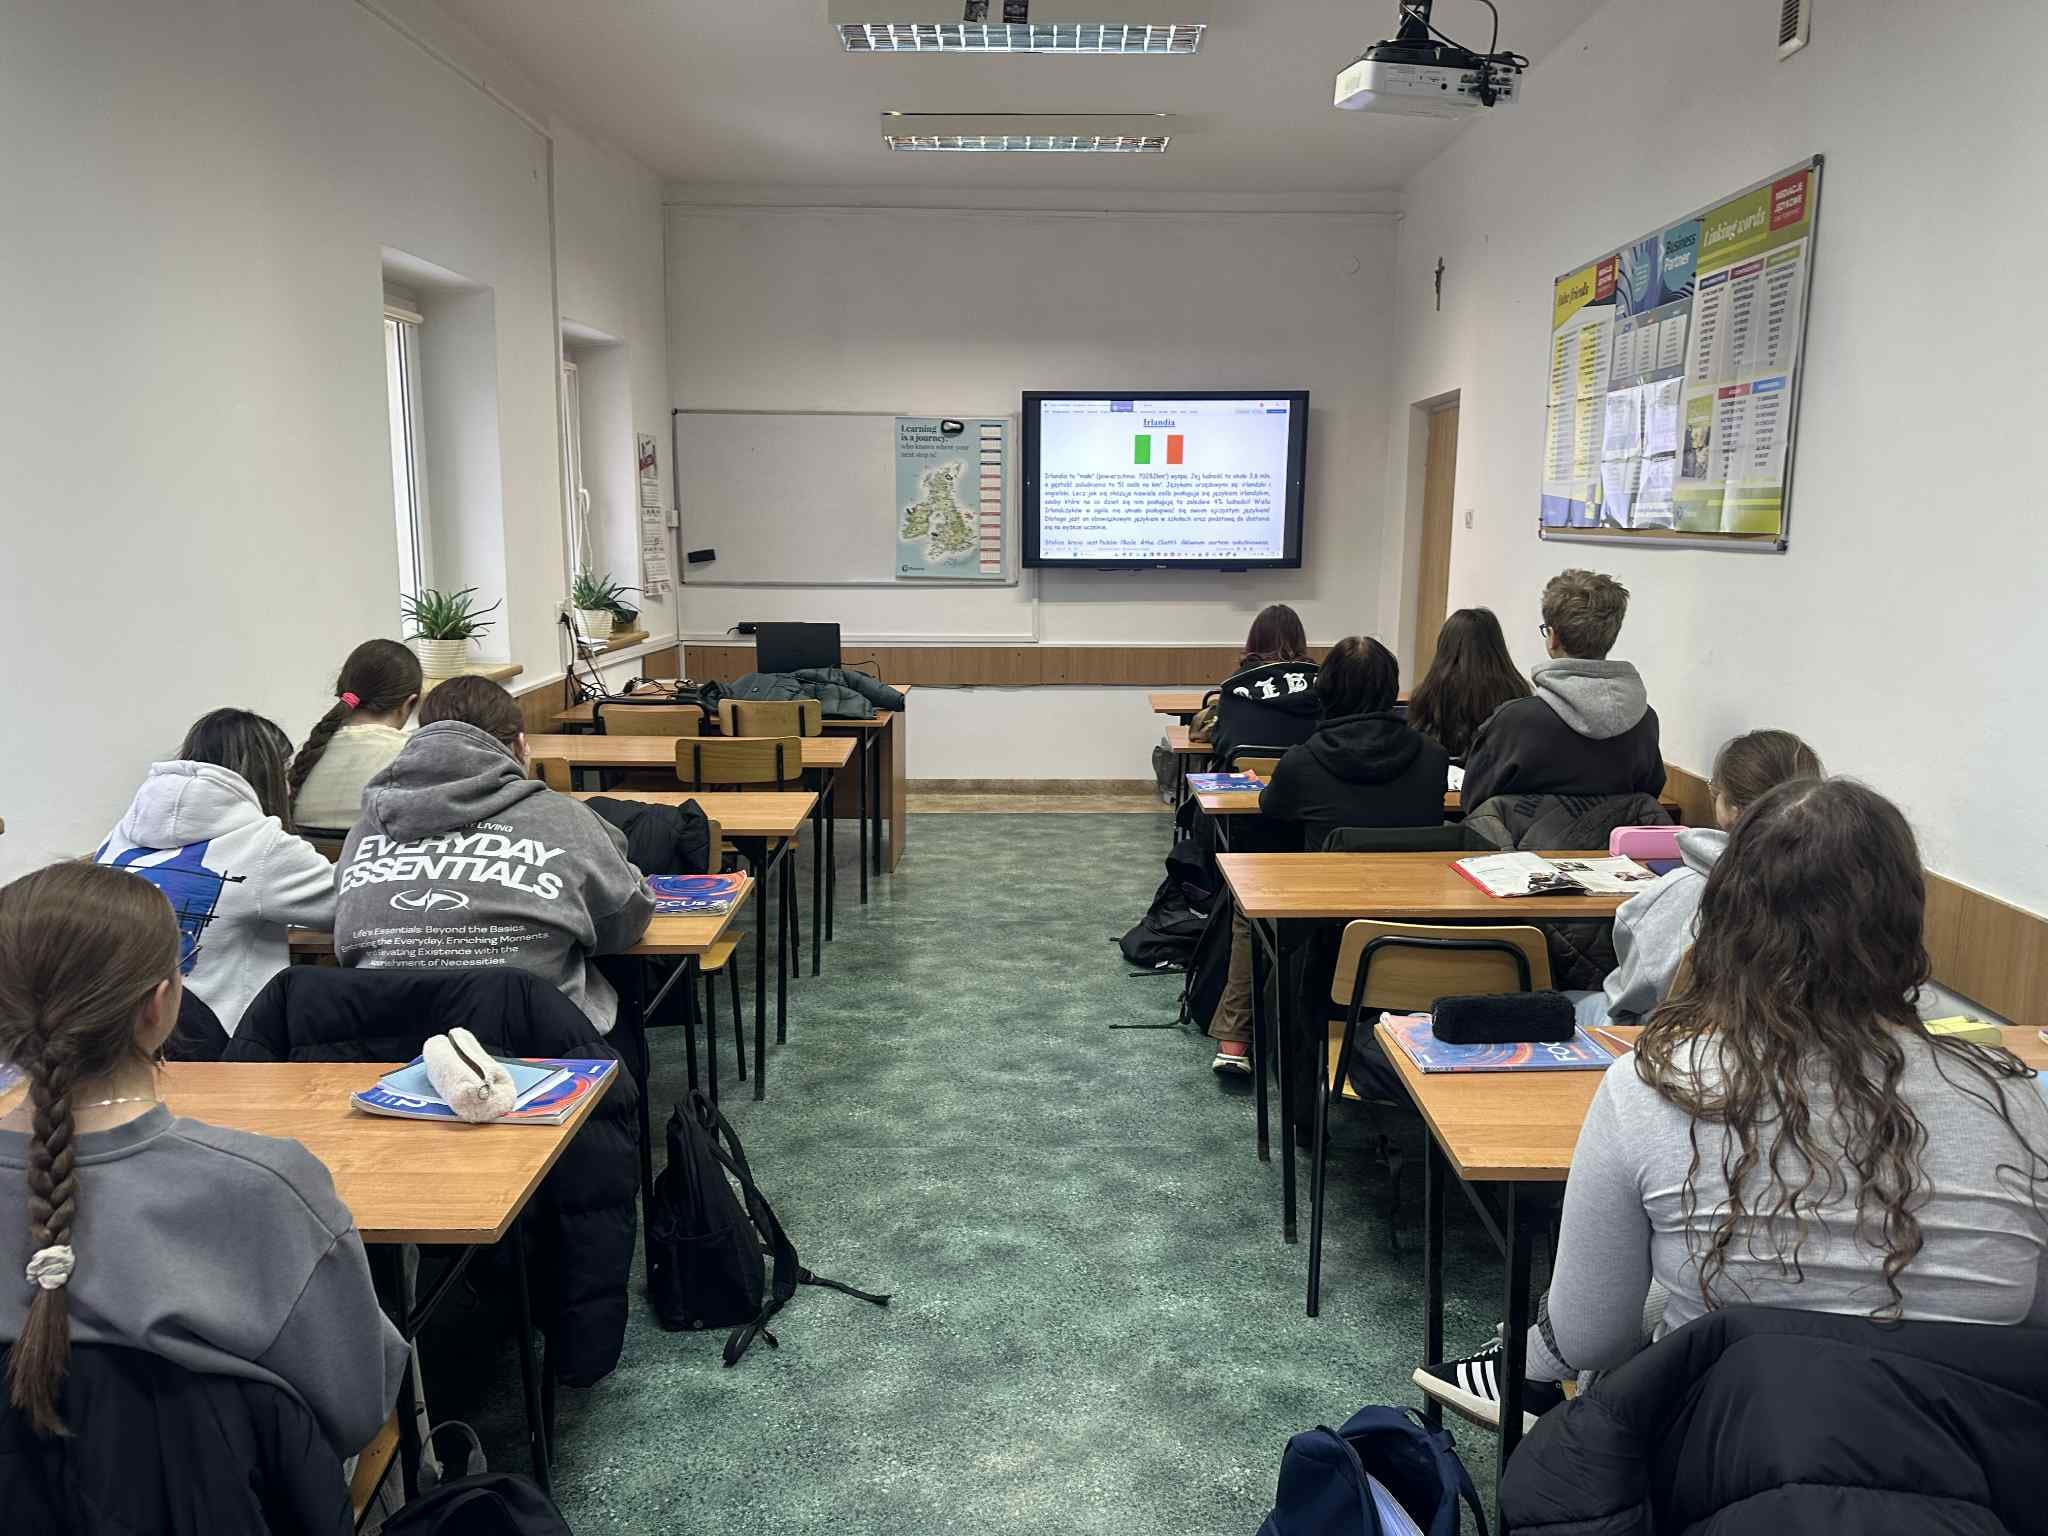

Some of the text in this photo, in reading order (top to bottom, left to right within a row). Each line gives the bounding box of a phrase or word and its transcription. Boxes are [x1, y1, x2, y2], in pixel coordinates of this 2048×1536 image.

[1666, 233, 1697, 255] Business
[1143, 418, 1176, 426] Irlandia
[901, 424, 937, 434] Learning
[1233, 672, 1318, 700] EB
[476, 822, 514, 833] LIVING
[354, 831, 567, 867] EVERYDAY
[339, 855, 564, 900] ESSENTIALS
[425, 925, 466, 935] Beyond
[468, 925, 487, 933] the
[377, 937, 392, 945] the
[446, 936, 498, 946] Enriching
[418, 947, 471, 956] Existence
[474, 947, 498, 955] with
[428, 958, 440, 967] of
